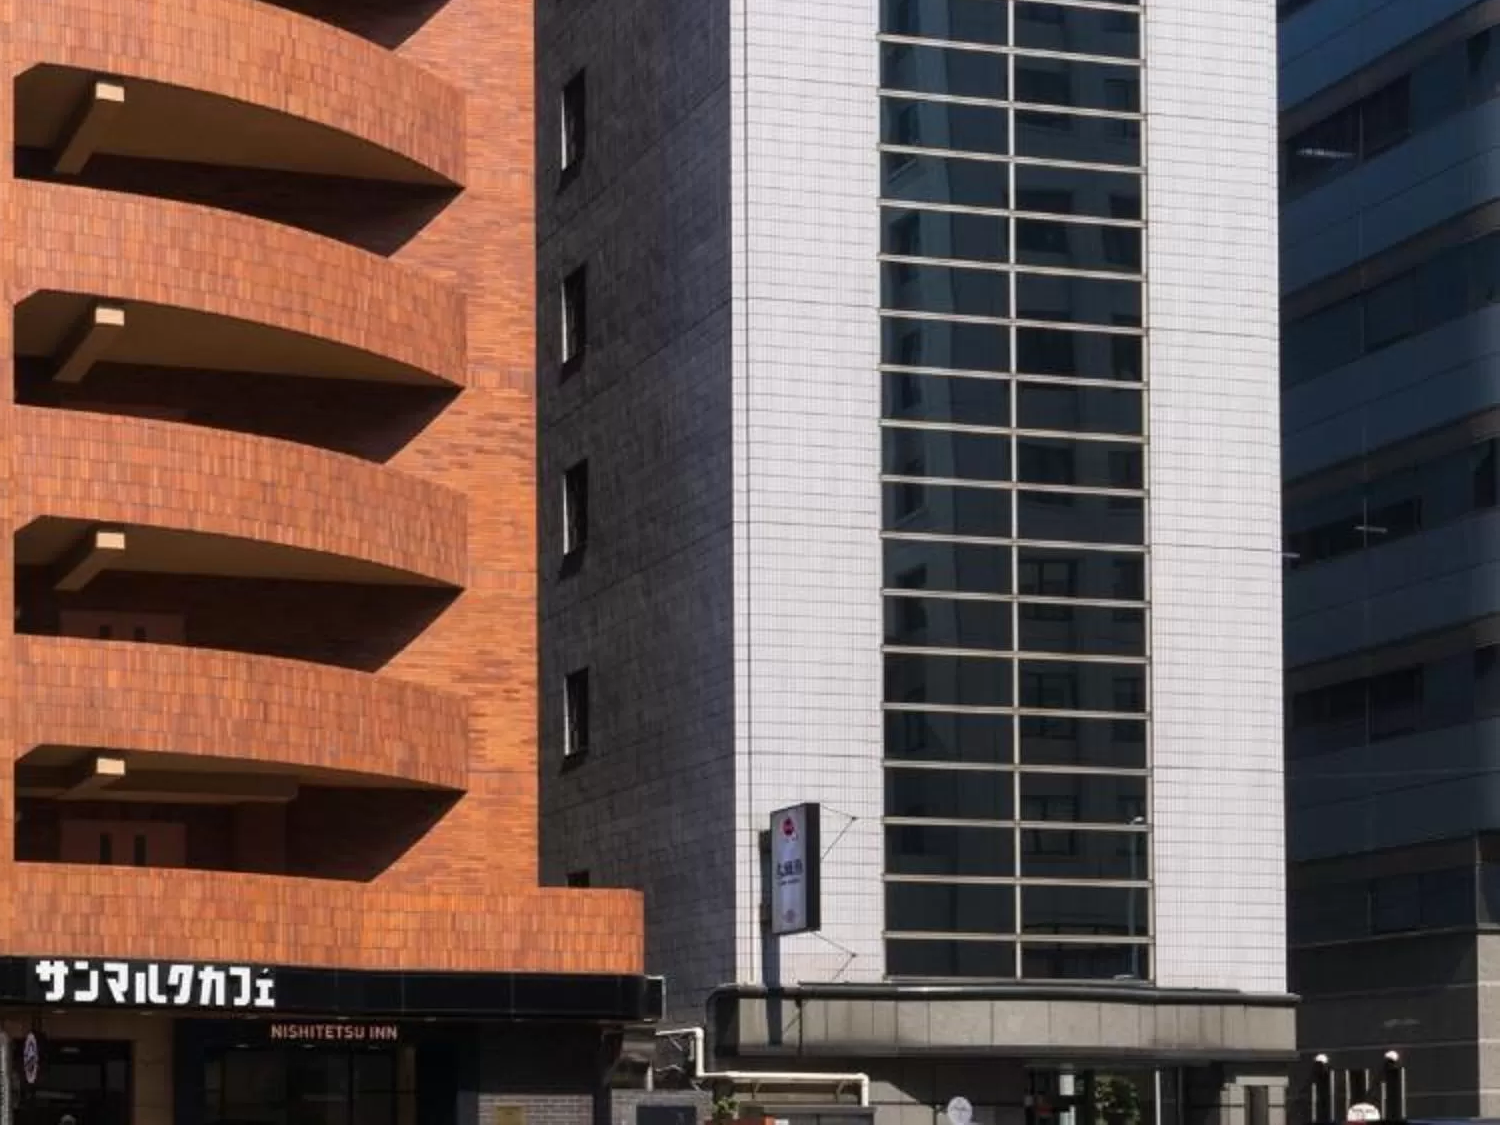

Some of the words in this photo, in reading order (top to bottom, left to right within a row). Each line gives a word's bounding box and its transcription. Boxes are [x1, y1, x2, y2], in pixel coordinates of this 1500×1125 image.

[35, 959, 276, 1008] サンマルクカフェ
[271, 1024, 365, 1039] NISHITETSU
[369, 1025, 397, 1040] INN
